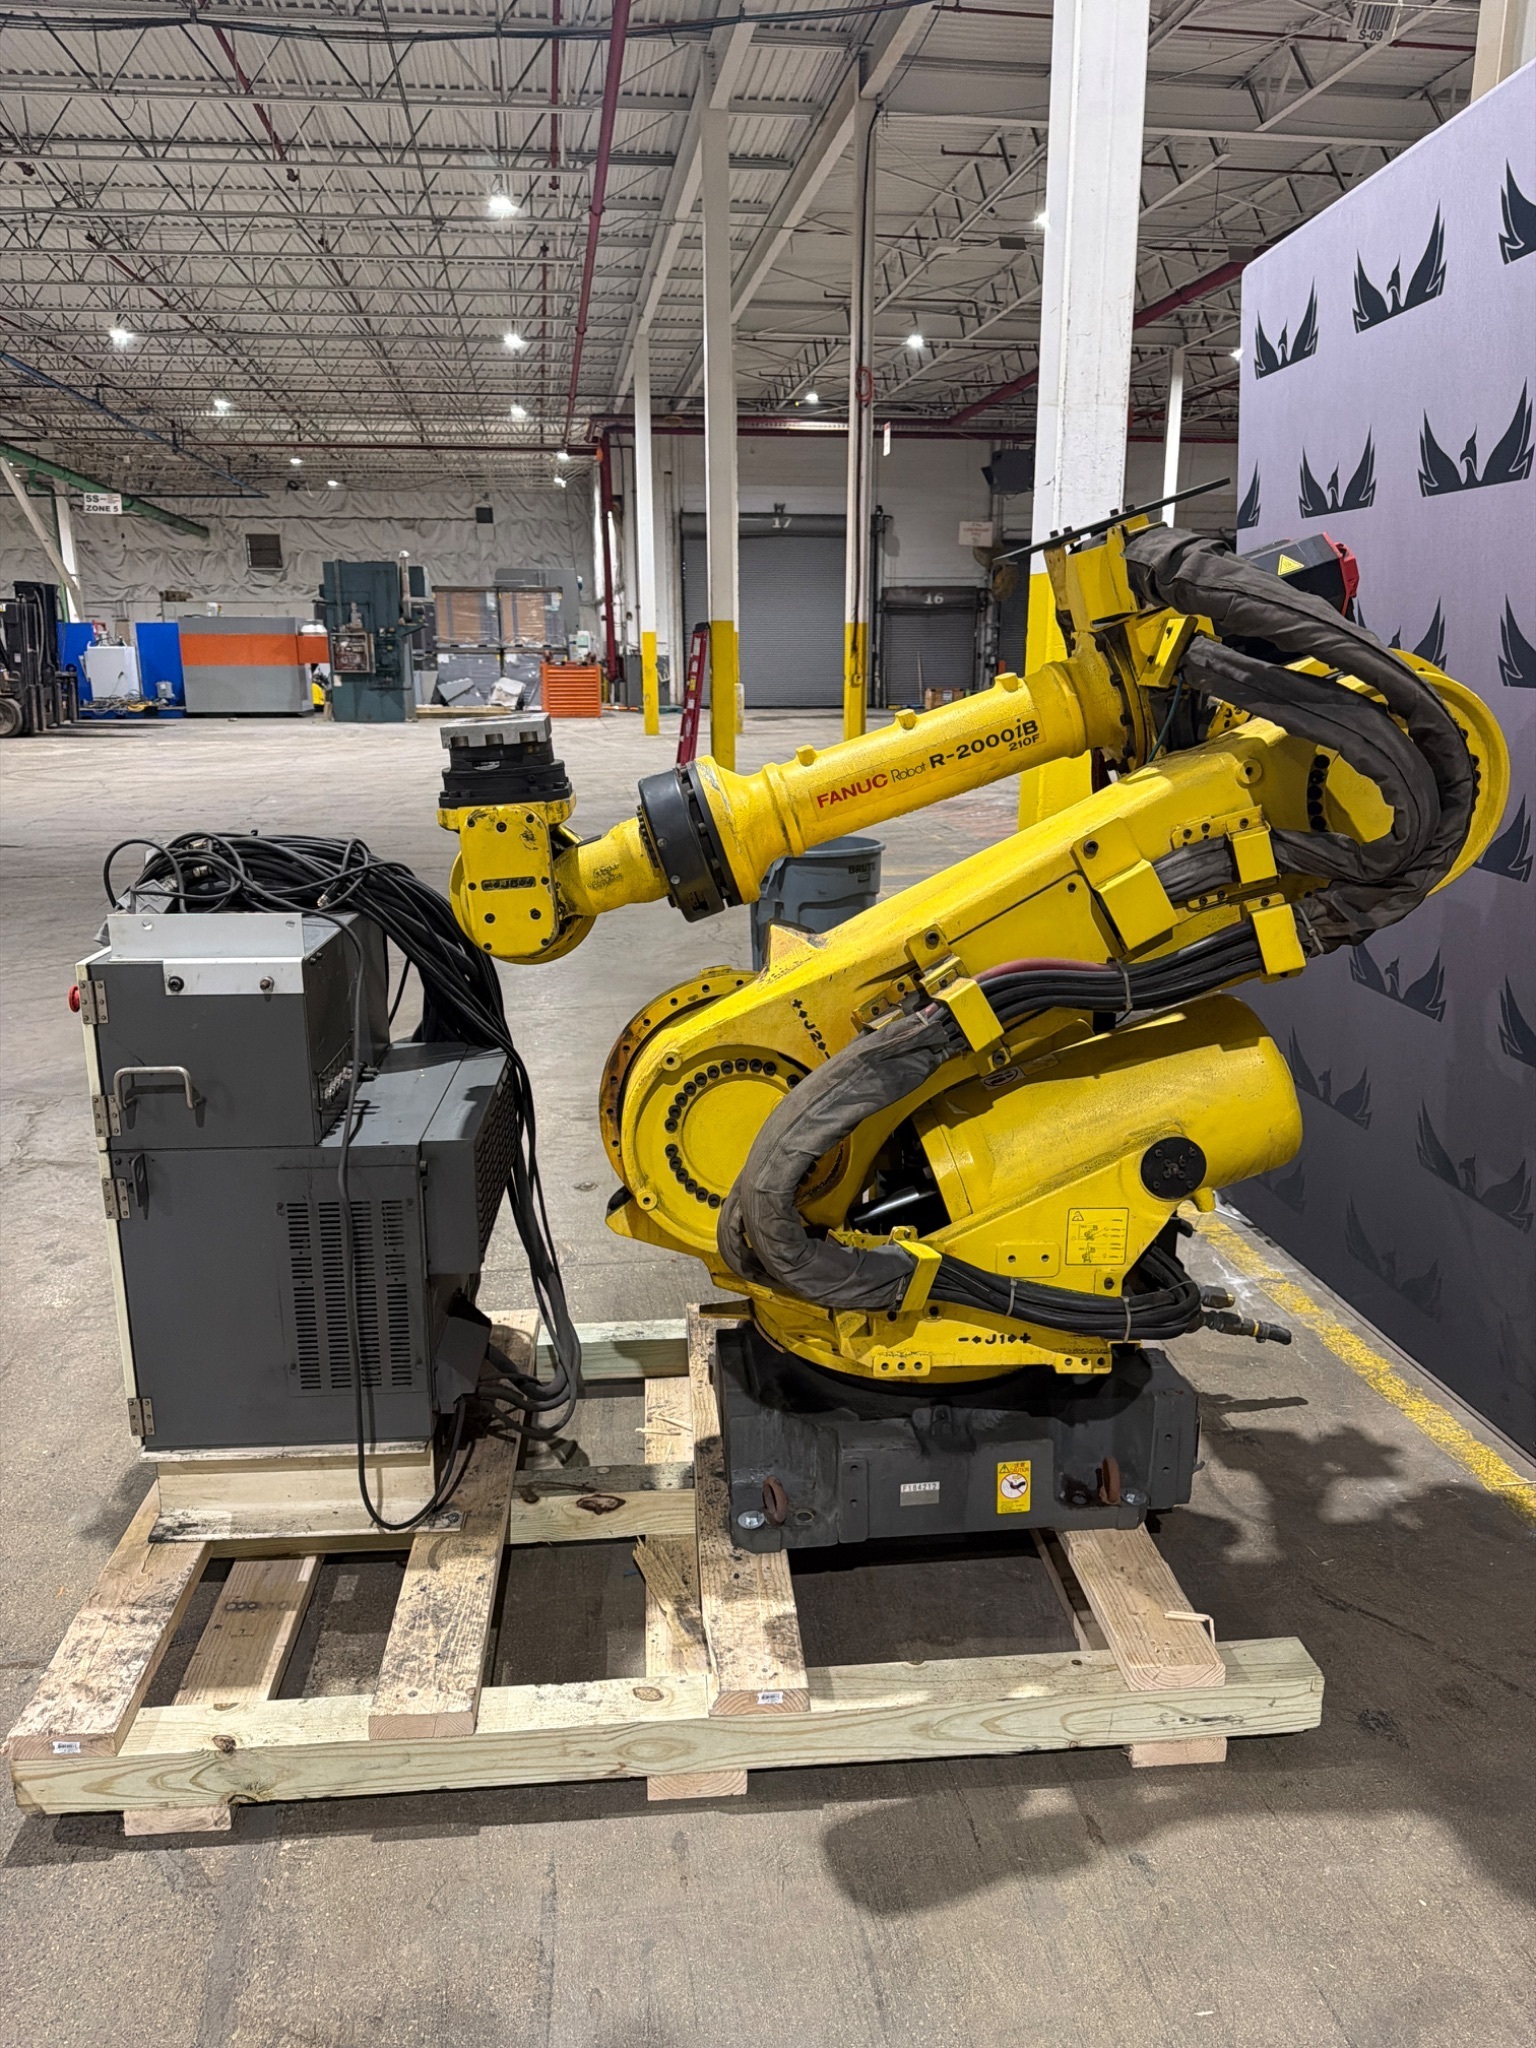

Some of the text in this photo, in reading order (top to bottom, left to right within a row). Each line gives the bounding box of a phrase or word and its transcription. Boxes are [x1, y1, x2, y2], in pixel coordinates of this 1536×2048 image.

[1358, 30, 1383, 41] S-09
[86, 504, 111, 512] ZONE
[772, 516, 792, 528] 17
[925, 592, 944, 604] 16
[1008, 733, 1040, 752] 210F
[816, 718, 1039, 809] FANUC Robot R-2000iB
